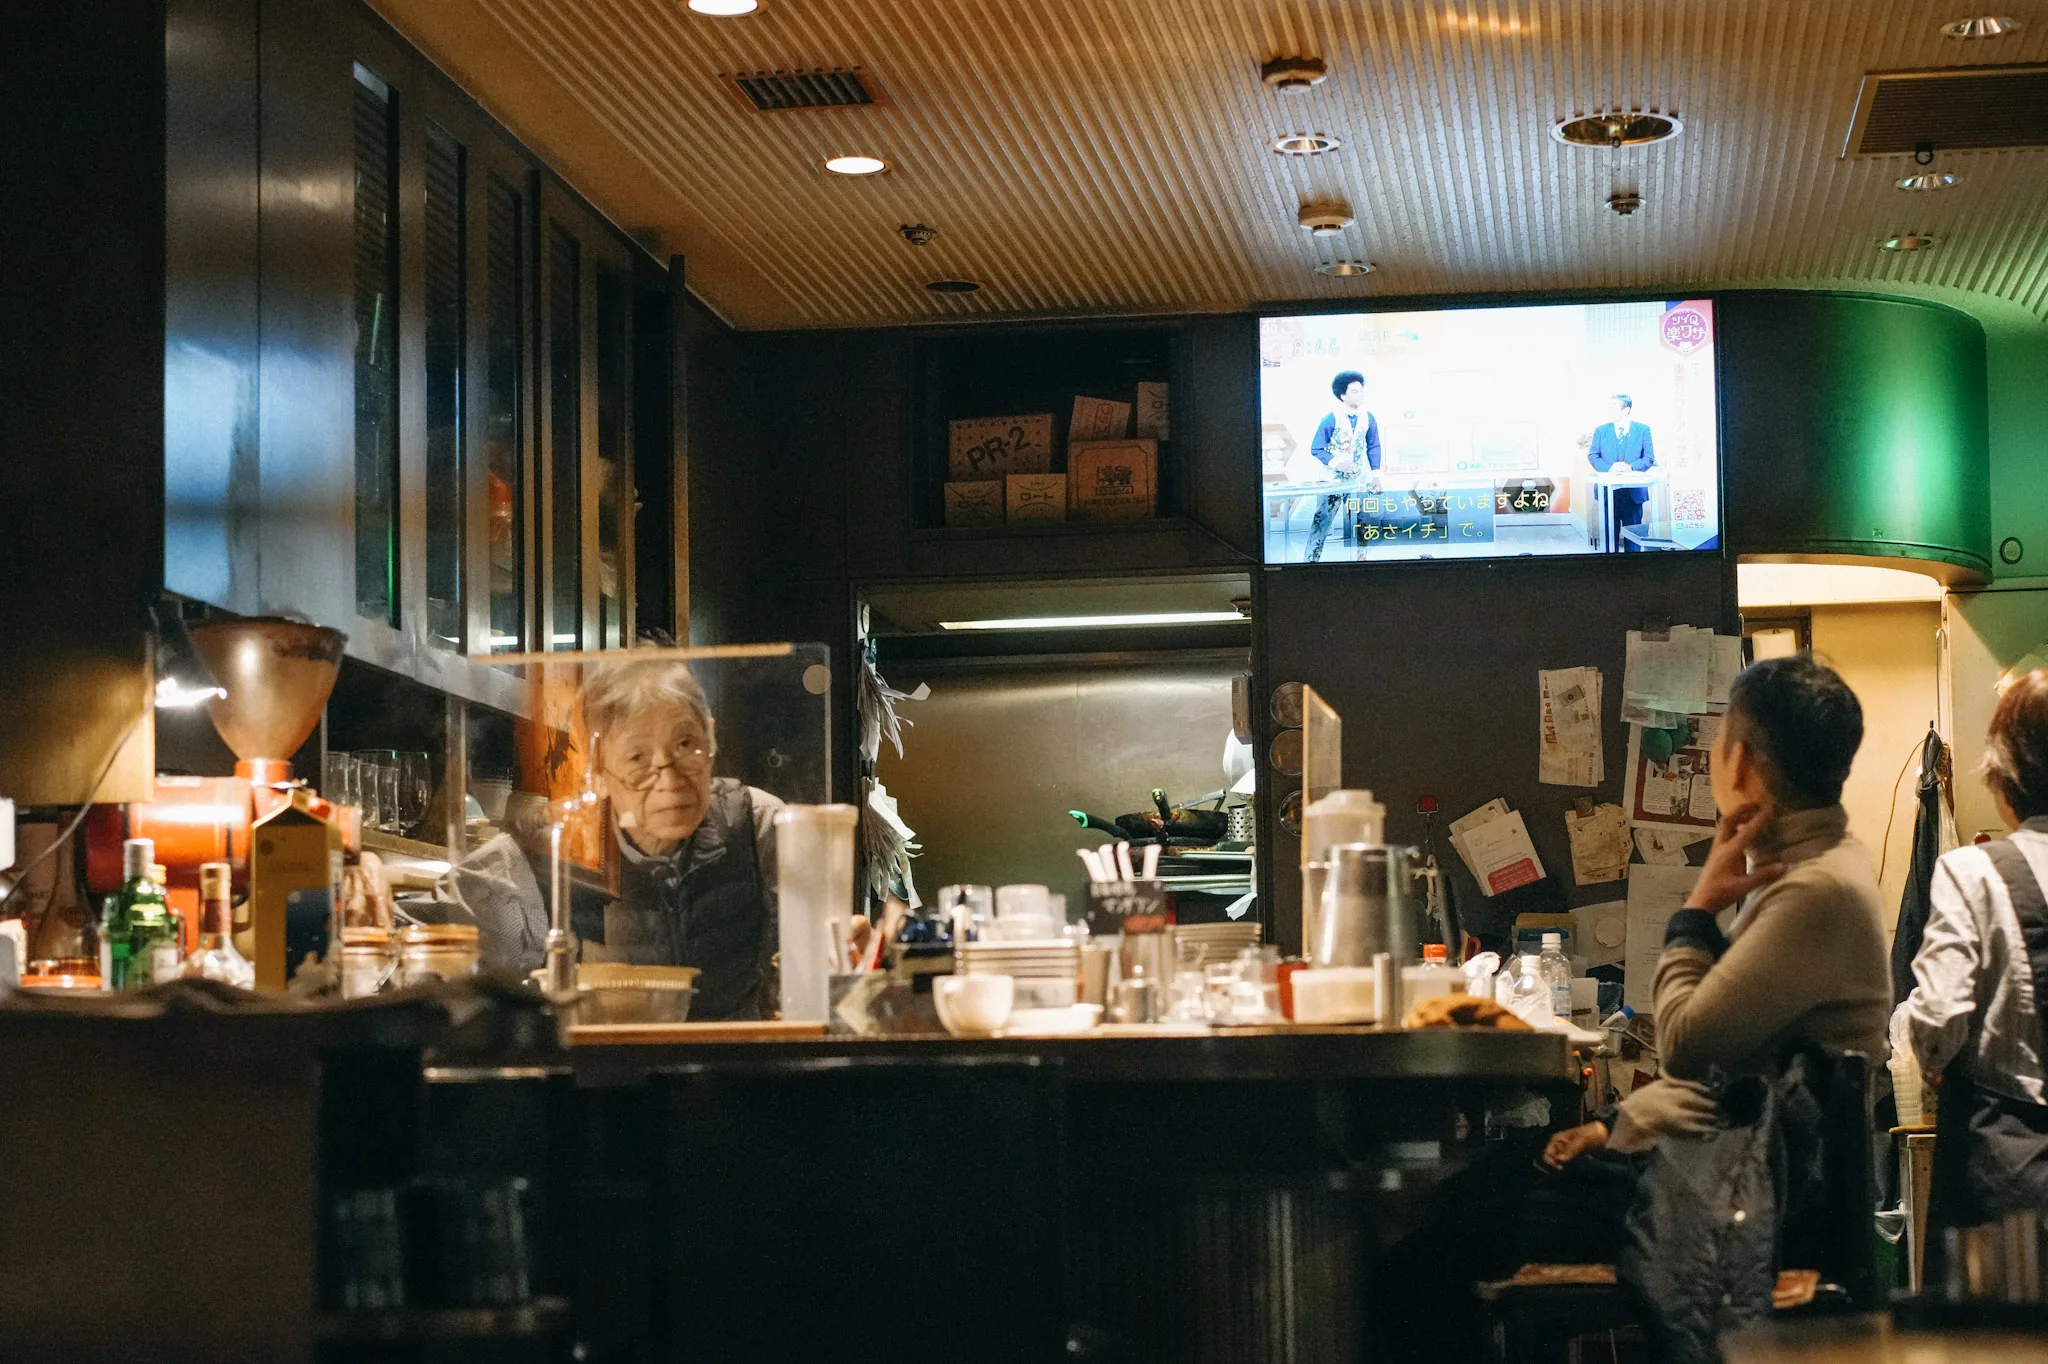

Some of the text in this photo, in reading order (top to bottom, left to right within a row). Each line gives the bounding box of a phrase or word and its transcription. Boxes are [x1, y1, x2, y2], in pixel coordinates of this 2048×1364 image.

[1343, 491, 1551, 514] 何回もやっていますよね
[1350, 522, 1485, 542] 「あさイチ」で。
